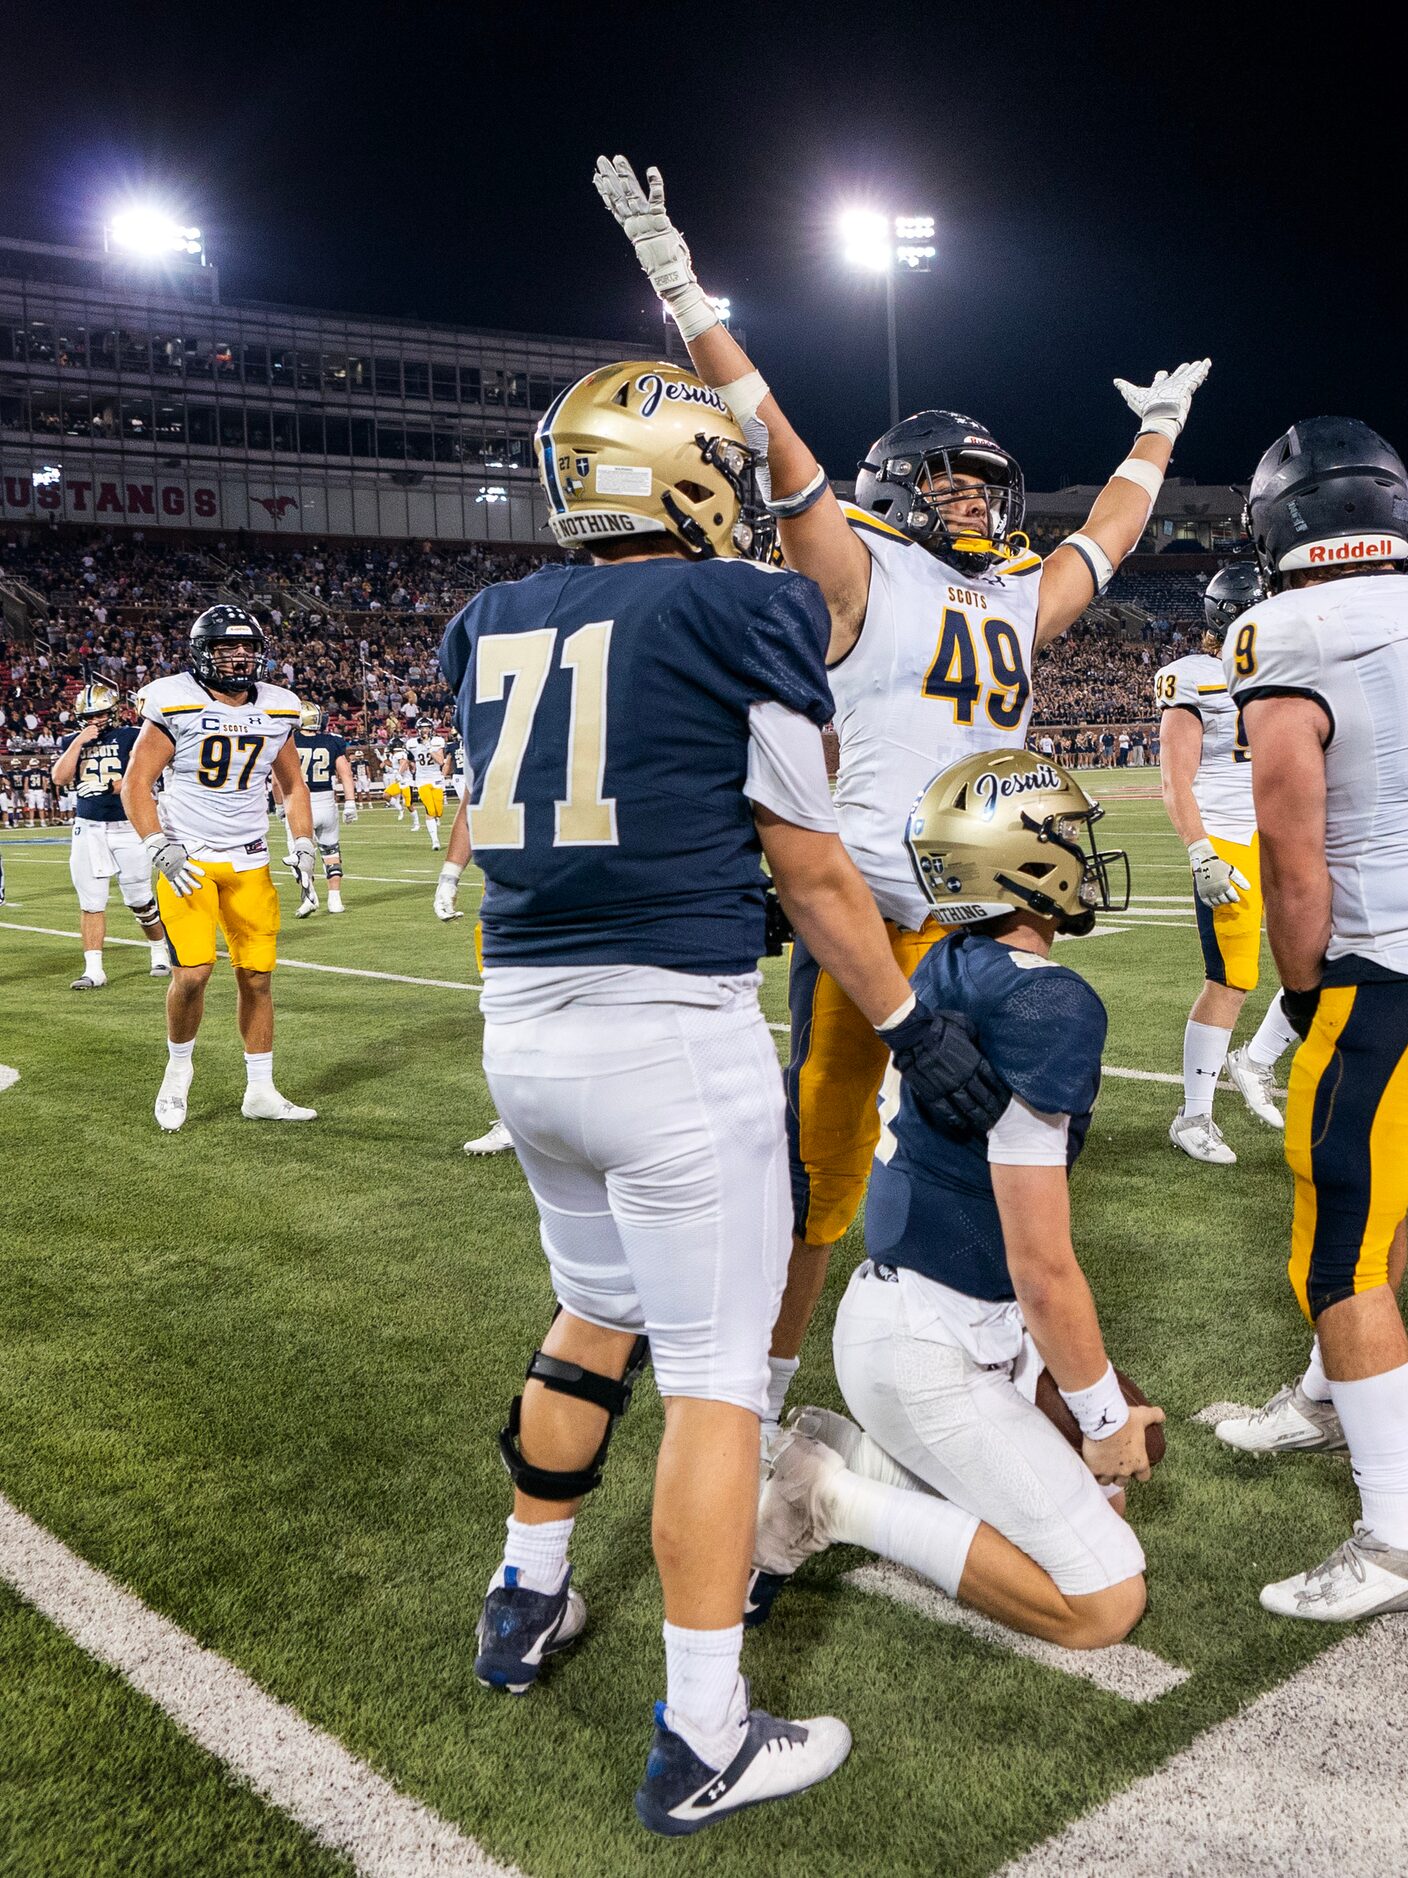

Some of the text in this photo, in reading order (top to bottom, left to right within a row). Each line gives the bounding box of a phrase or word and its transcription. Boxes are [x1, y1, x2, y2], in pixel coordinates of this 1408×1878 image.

[0, 476, 217, 518] USTANGS
[559, 514, 636, 537] NOTHING
[1309, 540, 1392, 563] Riddell
[948, 586, 988, 610] SCOTS
[1235, 622, 1259, 679] 9
[920, 606, 1031, 732] 49
[223, 723, 249, 733] SCOTS
[466, 619, 620, 850] 71
[80, 757, 123, 785] 66
[198, 734, 265, 792] 97
[299, 747, 331, 783] 72
[418, 753, 436, 767] 32
[973, 763, 1062, 823] Jesuit
[930, 904, 989, 923] OTHING
